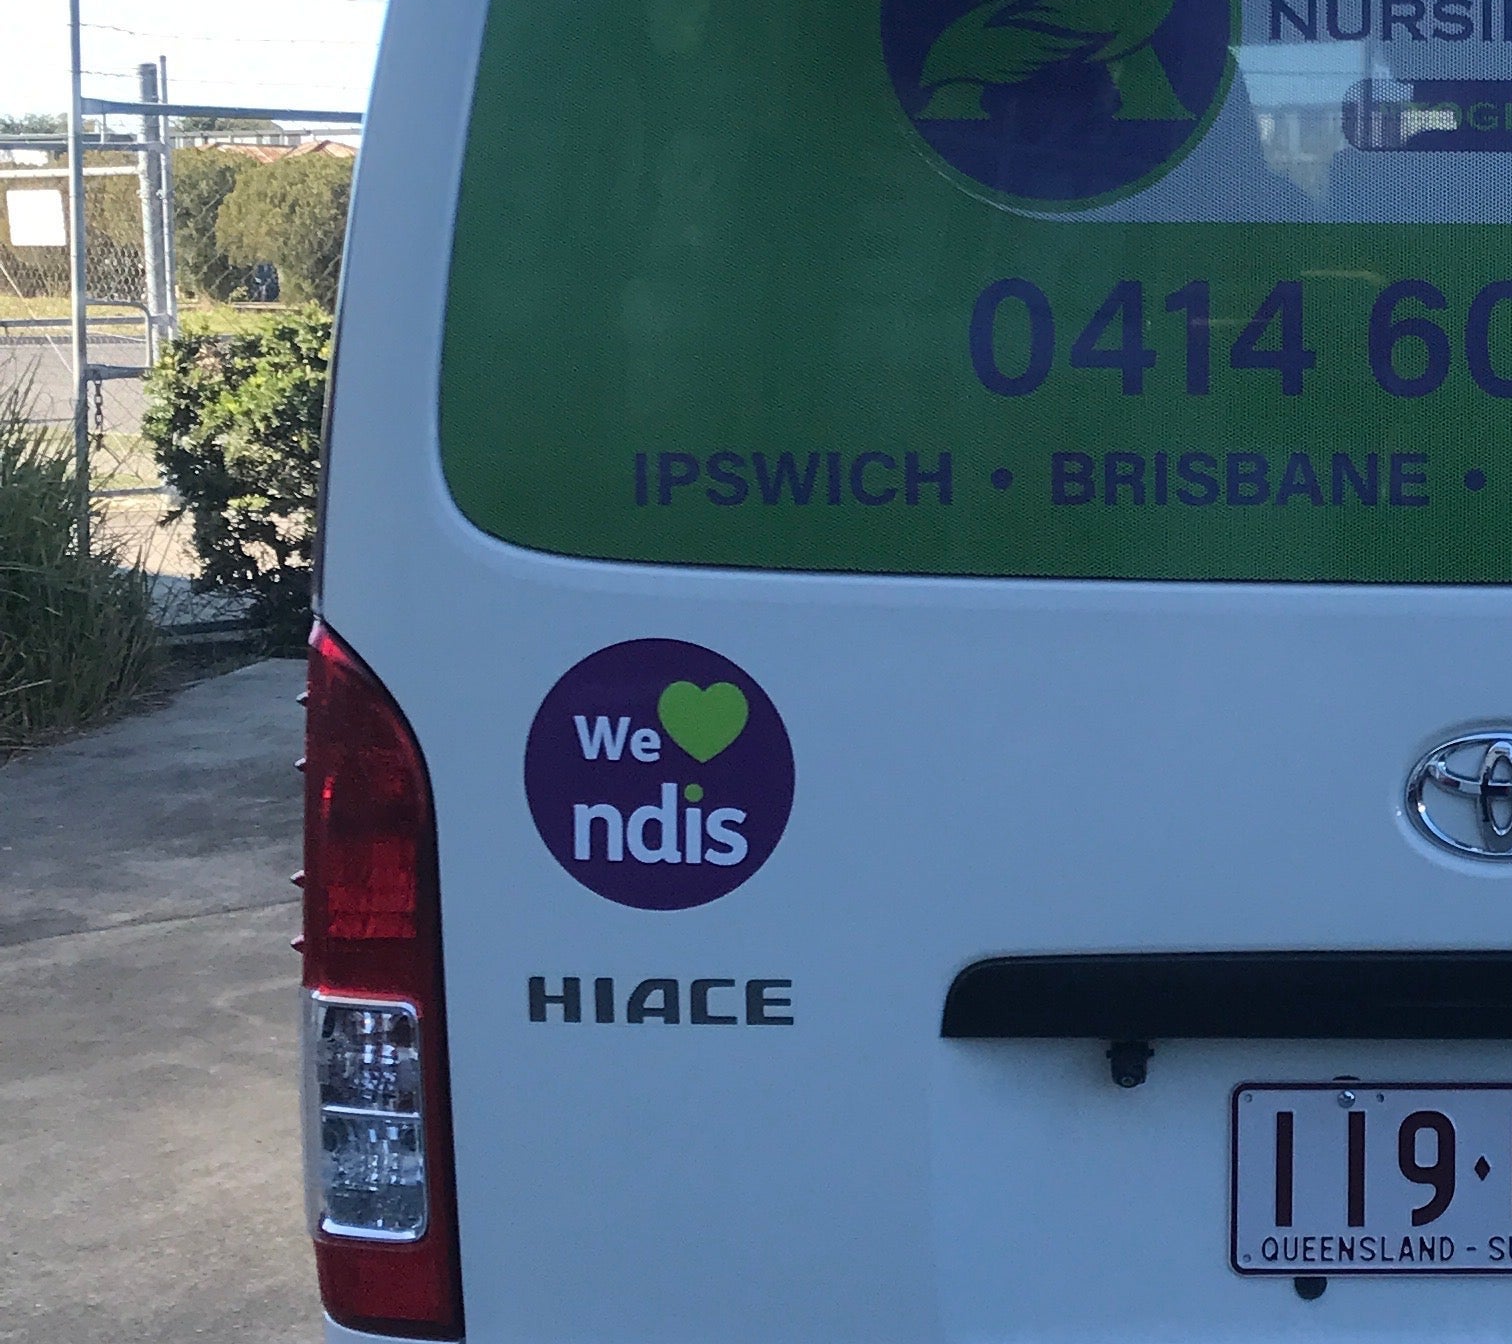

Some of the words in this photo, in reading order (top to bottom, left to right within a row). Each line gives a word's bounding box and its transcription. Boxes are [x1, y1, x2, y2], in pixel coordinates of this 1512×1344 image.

[968, 276, 1319, 398] 0414
[633, 450, 954, 508] IPSWICH
[1049, 452, 1431, 509] BRISBANE
[573, 715, 662, 763] We
[573, 782, 749, 867] ndis
[528, 976, 795, 1026] HIACE
[1261, 1235, 1456, 1262] QUEENSLAND
